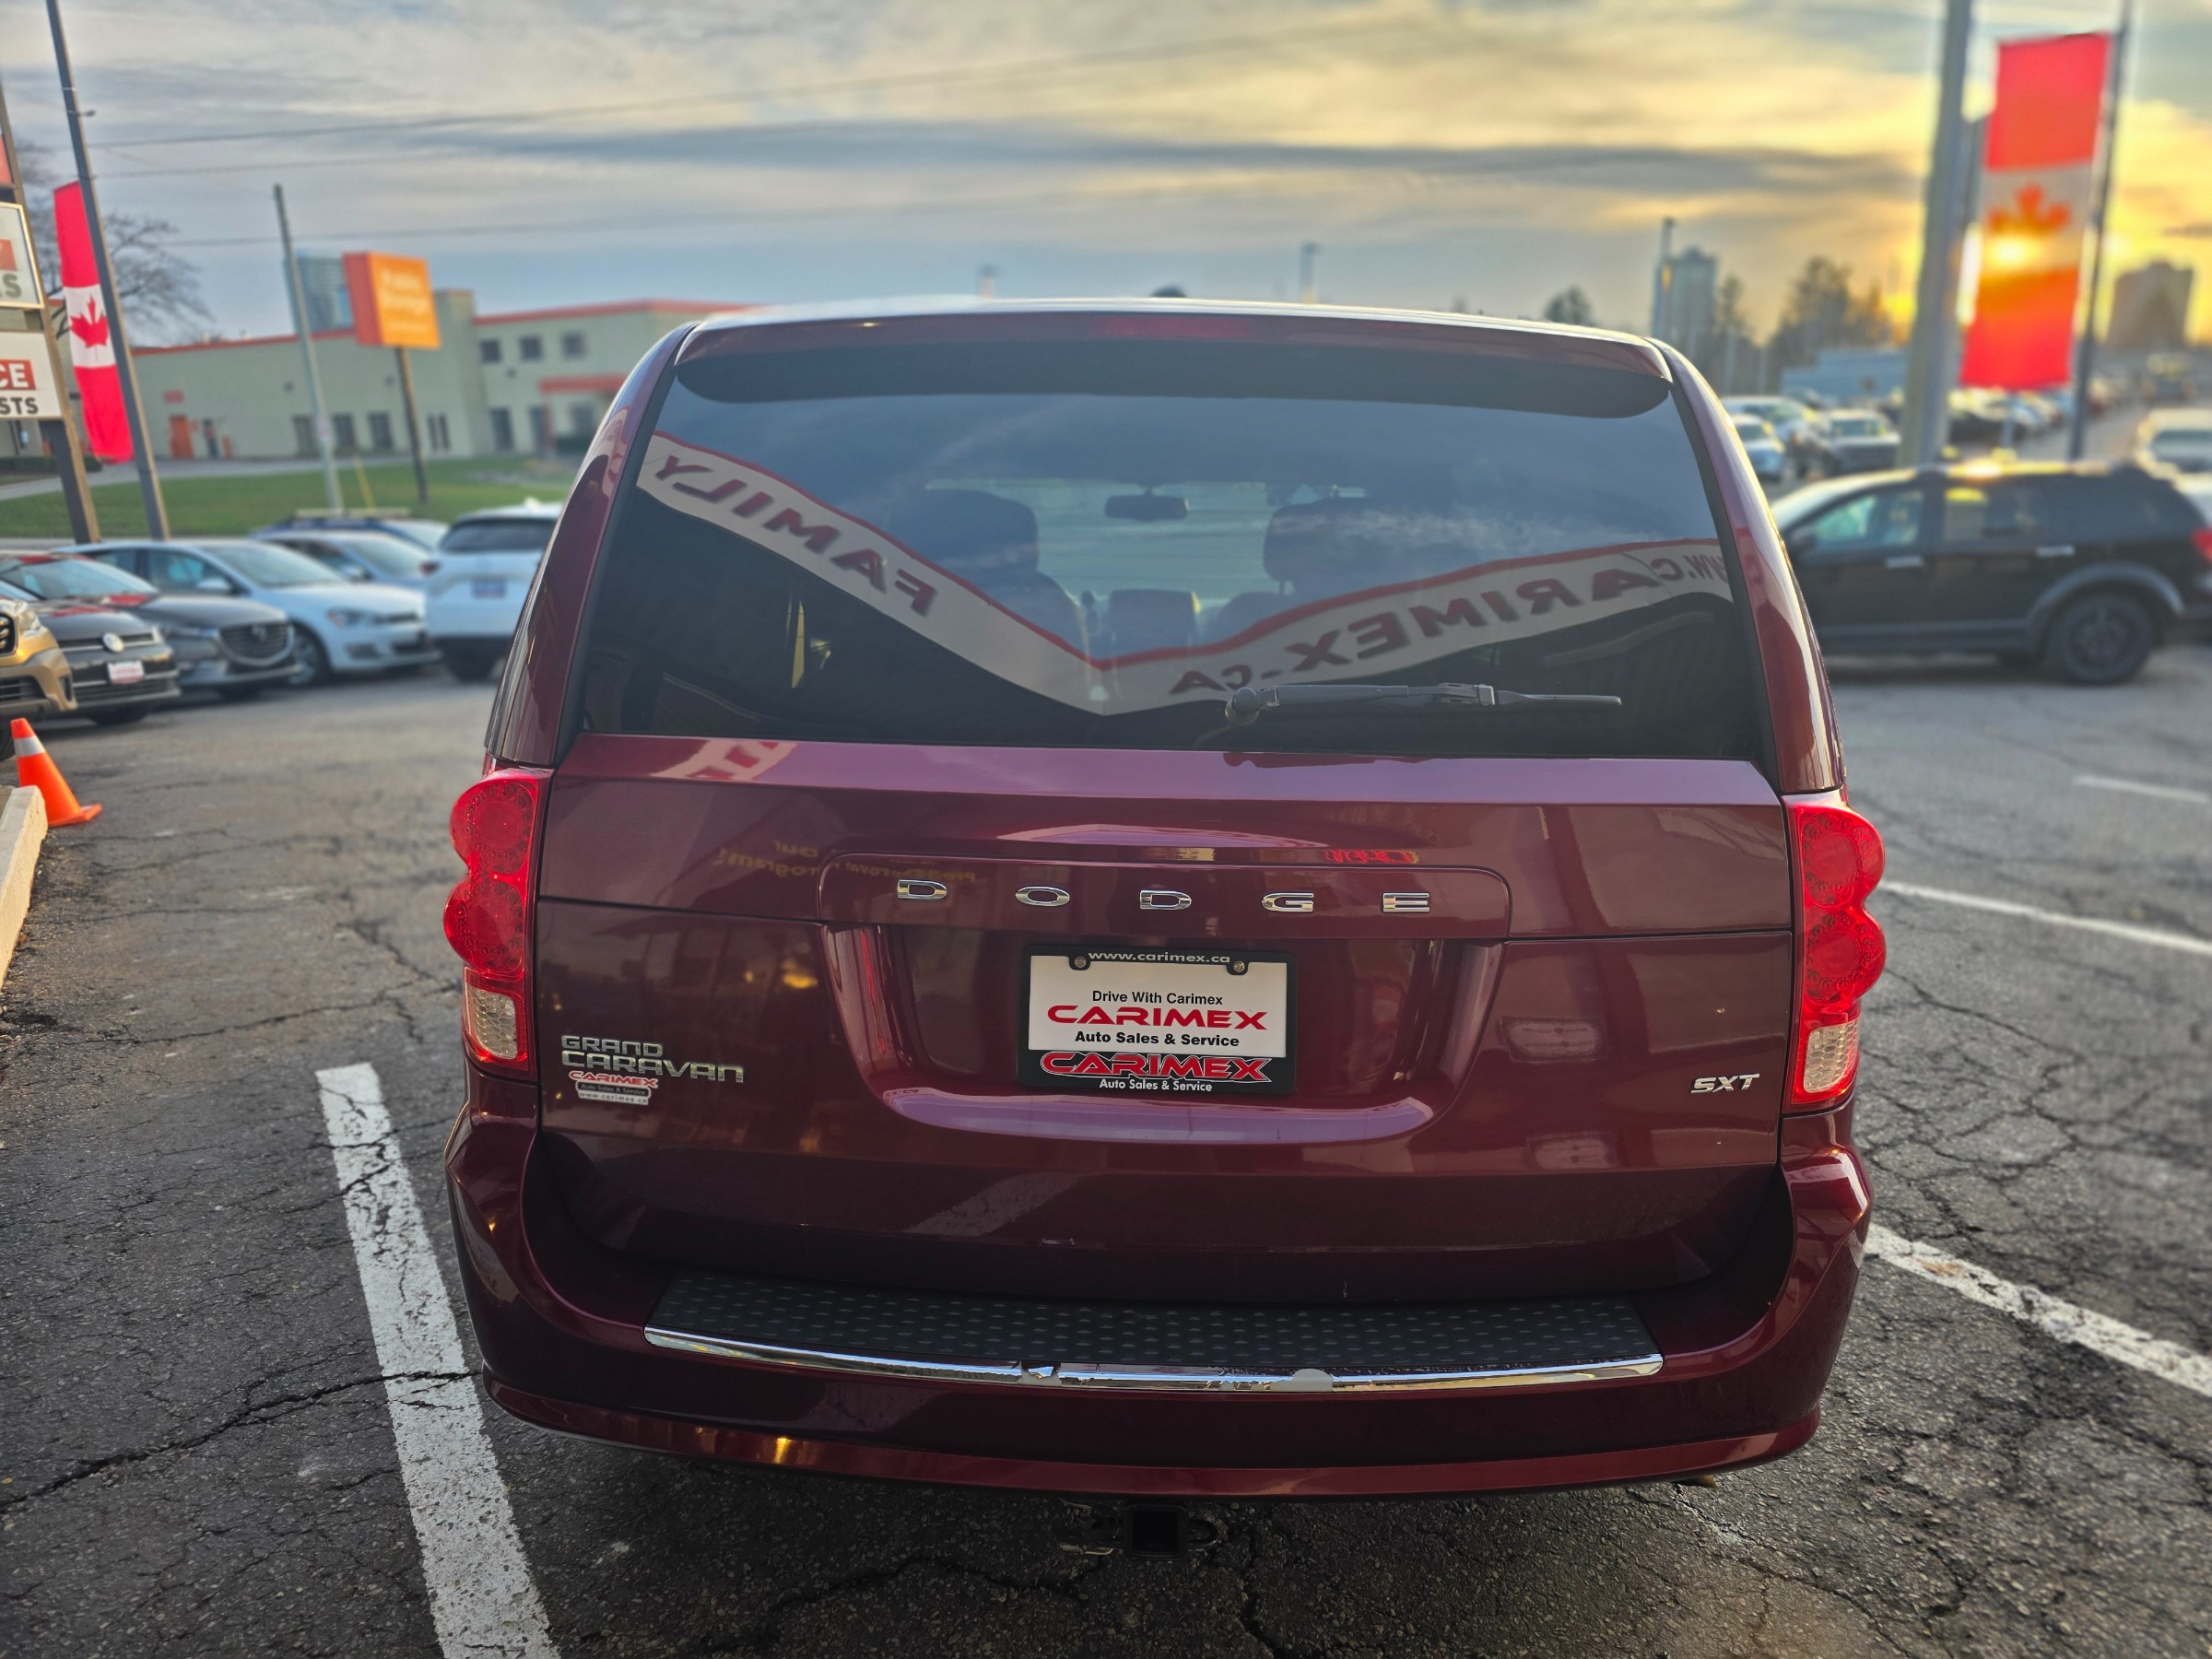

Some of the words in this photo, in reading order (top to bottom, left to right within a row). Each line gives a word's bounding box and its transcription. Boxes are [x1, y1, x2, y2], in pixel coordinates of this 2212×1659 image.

[897, 878, 1430, 913] DODGE
[1088, 952, 1230, 963] www.carimex.ca
[1092, 990, 1128, 1003] Drive
[1132, 991, 1162, 1005] With
[1166, 992, 1223, 1006] Carimex
[1047, 1005, 1267, 1030] CARIMEX
[561, 1035, 663, 1057] GRAND
[1075, 1030, 1112, 1043] Auto
[1116, 1031, 1159, 1045] Sales
[1164, 1033, 1177, 1045] &
[1181, 1033, 1241, 1047] Service
[561, 1050, 744, 1083] CARAVAN
[1041, 1051, 1272, 1083] CARIMEX
[570, 1071, 658, 1088] CARIMEX
[1099, 1078, 1126, 1089] Auto
[1129, 1078, 1159, 1091] Sales
[1161, 1080, 1171, 1091] &
[1172, 1080, 1213, 1093] Service
[1690, 1073, 1760, 1094] SXT
[623, 1087, 646, 1096] Service
